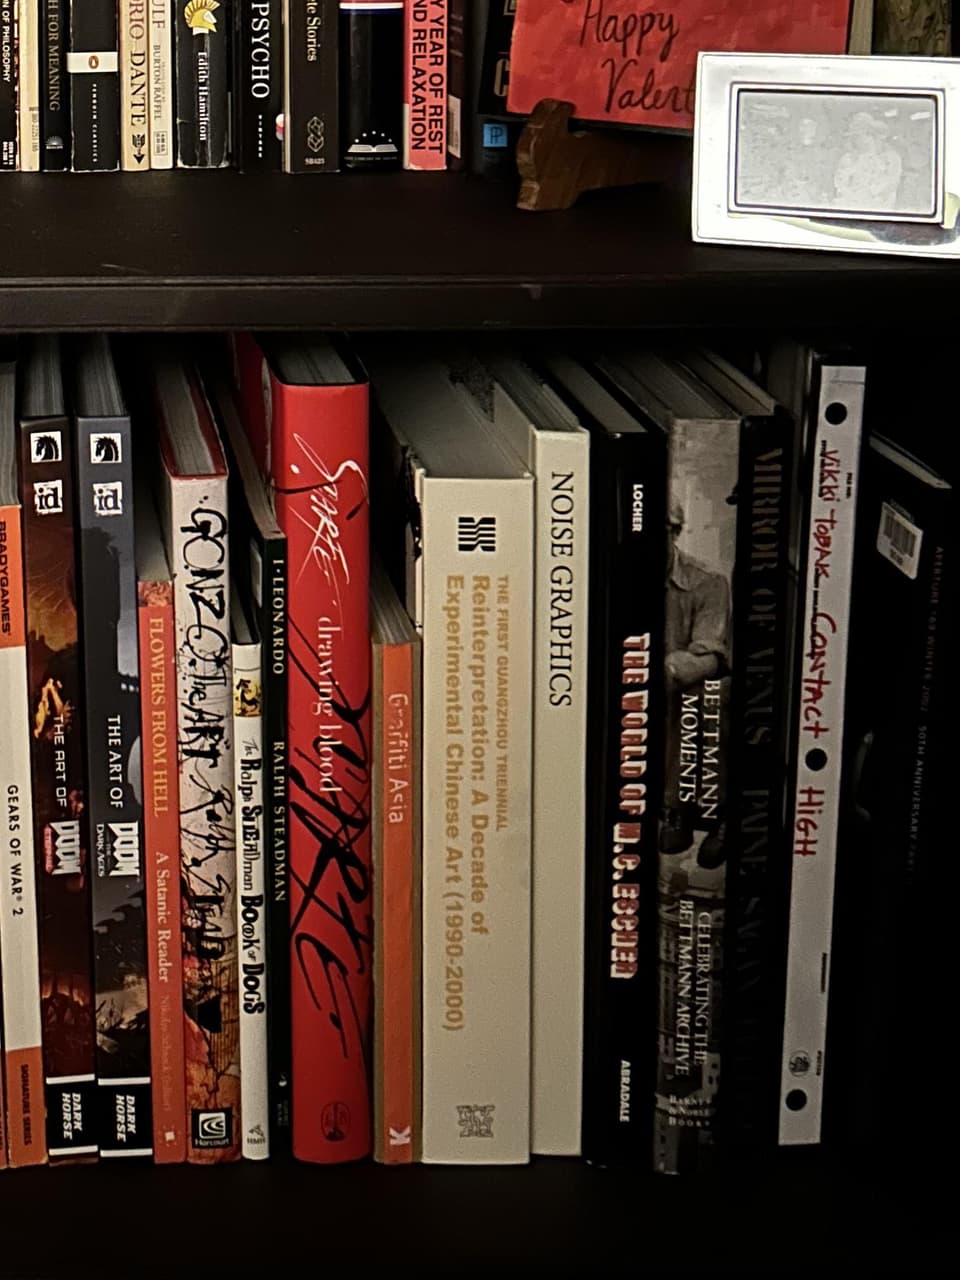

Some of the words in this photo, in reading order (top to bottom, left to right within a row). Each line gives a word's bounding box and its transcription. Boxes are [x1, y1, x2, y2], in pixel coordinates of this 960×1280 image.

[47, 14, 60, 41] FOR
[251, 2, 271, 99] PSYCHO
[428, 14, 445, 69] YEAR
[48, 45, 61, 112] MEANING
[130, 51, 147, 126] DANTE
[153, 43, 162, 78] BURTON
[428, 72, 444, 100] OF
[154, 80, 163, 121] RAFFEL
[411, 30, 429, 151] RELAXATION
[427, 104, 444, 155] REST
[550, 471, 575, 558] NOISE
[631, 483, 644, 533] LOCHER
[149, 616, 167, 706] FLOWERS
[442, 574, 465, 738] Experimental
[549, 565, 574, 707] GRAPHICS
[152, 711, 169, 763] FROM
[679, 692, 699, 803] MOMENTS
[701, 677, 721, 821] BETTMANN
[153, 768, 170, 819] HELL
[272, 740, 286, 798] RALPH
[445, 742, 465, 839] Chinese
[155, 851, 169, 865] A
[273, 804, 287, 902] STEADMAN
[445, 845, 464, 885] Art
[156, 868, 172, 925] Satanic
[158, 927, 173, 985] Reader
[442, 891, 465, 1032] (1990-2000)
[676, 899, 695, 999] BETTMANN
[674, 1001, 693, 1077] ARCHIVE
[61, 1091, 73, 1140] HORSE
[71, 1091, 83, 1132] DARK
[115, 1093, 127, 1143] HORSE
[619, 1059, 632, 1123] ABRADALE
